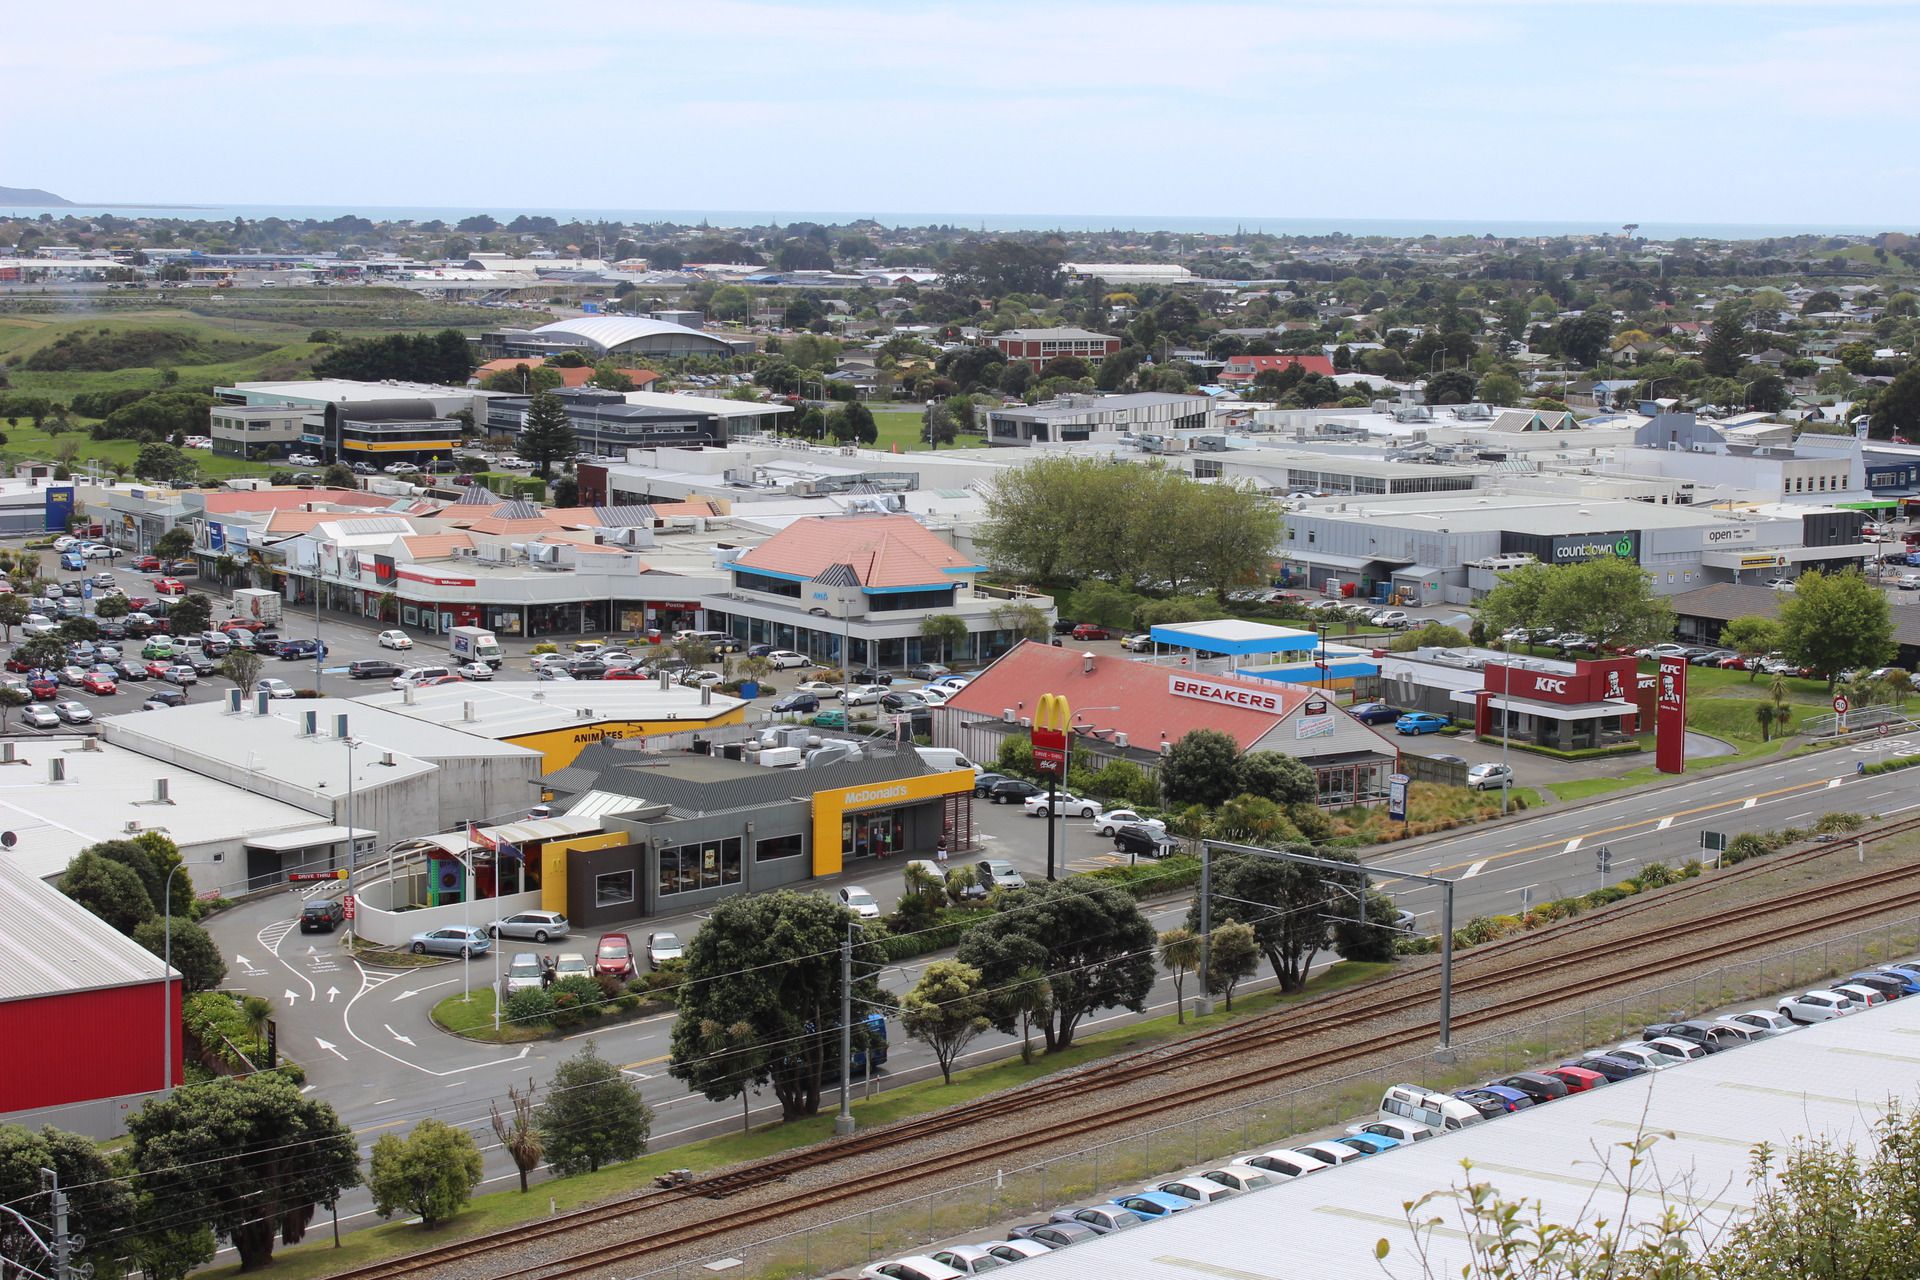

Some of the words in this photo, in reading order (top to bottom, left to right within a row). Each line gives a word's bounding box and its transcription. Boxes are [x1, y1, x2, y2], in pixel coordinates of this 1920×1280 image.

[1709, 530, 1732, 542] open
[1557, 543, 1612, 557] countdown
[1659, 664, 1681, 675] KFC
[1534, 677, 1566, 694] KFC
[1637, 679, 1656, 688] KFC
[1174, 681, 1276, 709] BREAKERS
[844, 785, 907, 804] McDonald's
